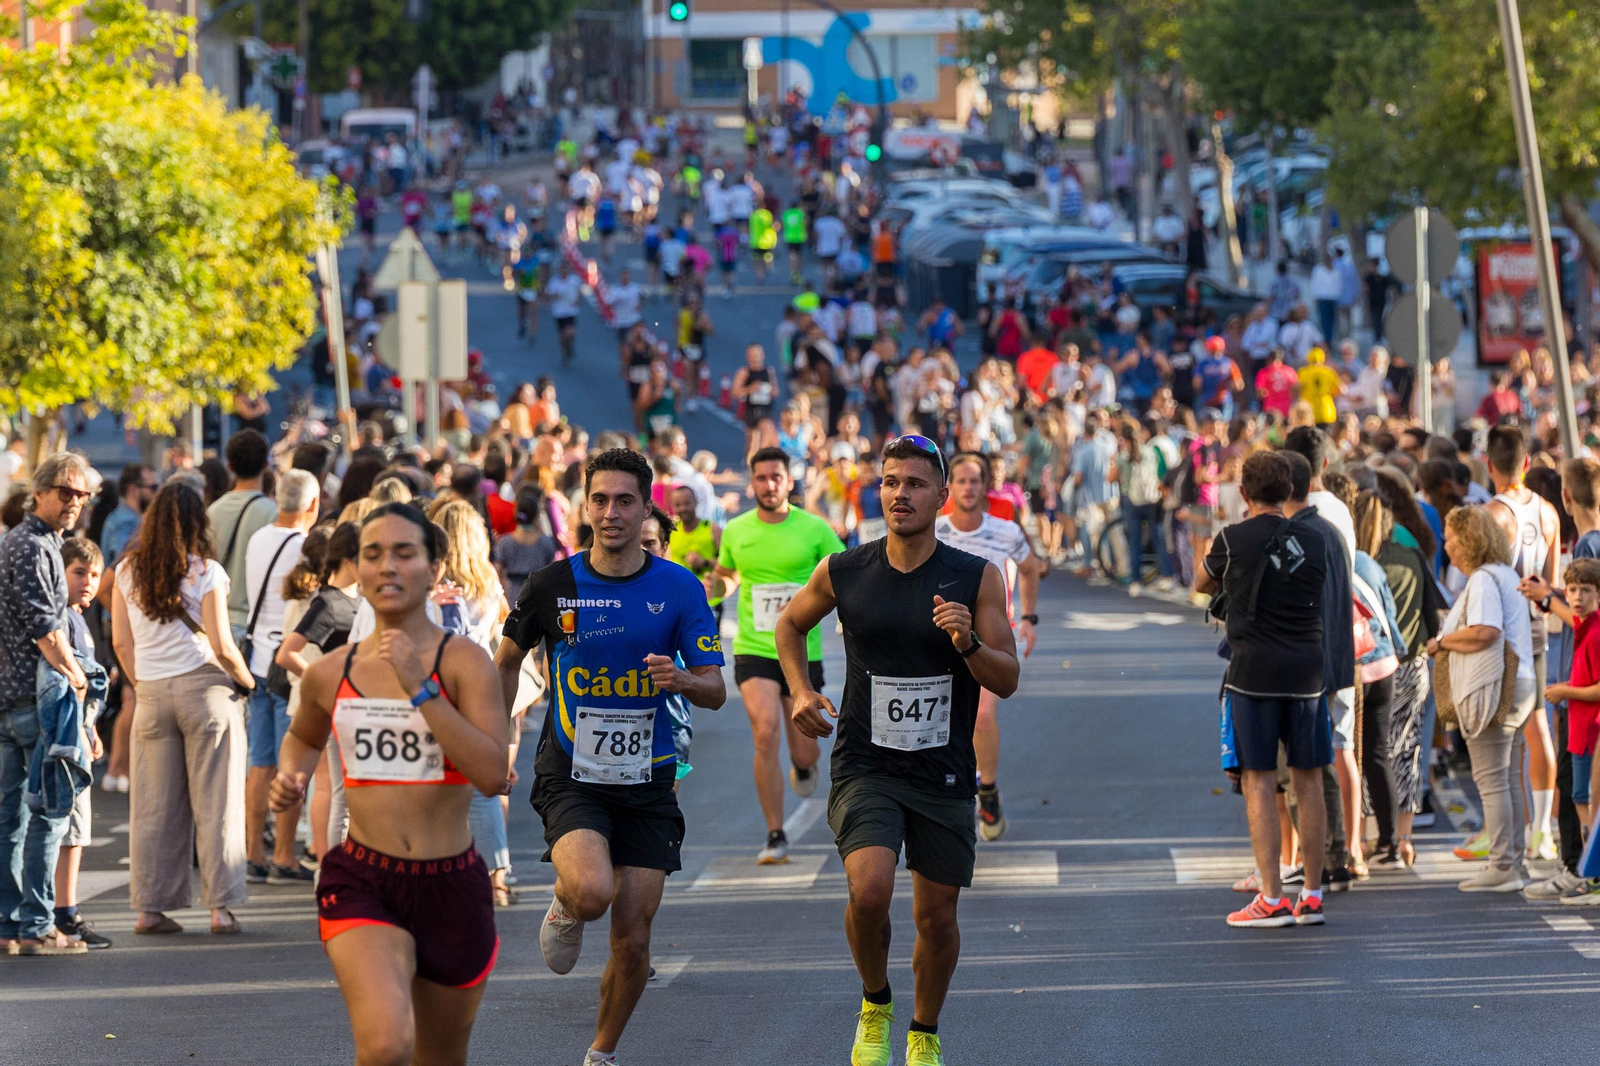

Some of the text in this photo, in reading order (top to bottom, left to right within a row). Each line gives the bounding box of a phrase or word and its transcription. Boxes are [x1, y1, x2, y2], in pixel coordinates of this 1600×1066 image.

[556, 597, 622, 609] Runners
[763, 597, 792, 612] 77
[596, 613, 607, 623] de
[888, 697, 939, 723] 647
[355, 728, 421, 763] 568
[592, 730, 641, 757] 788
